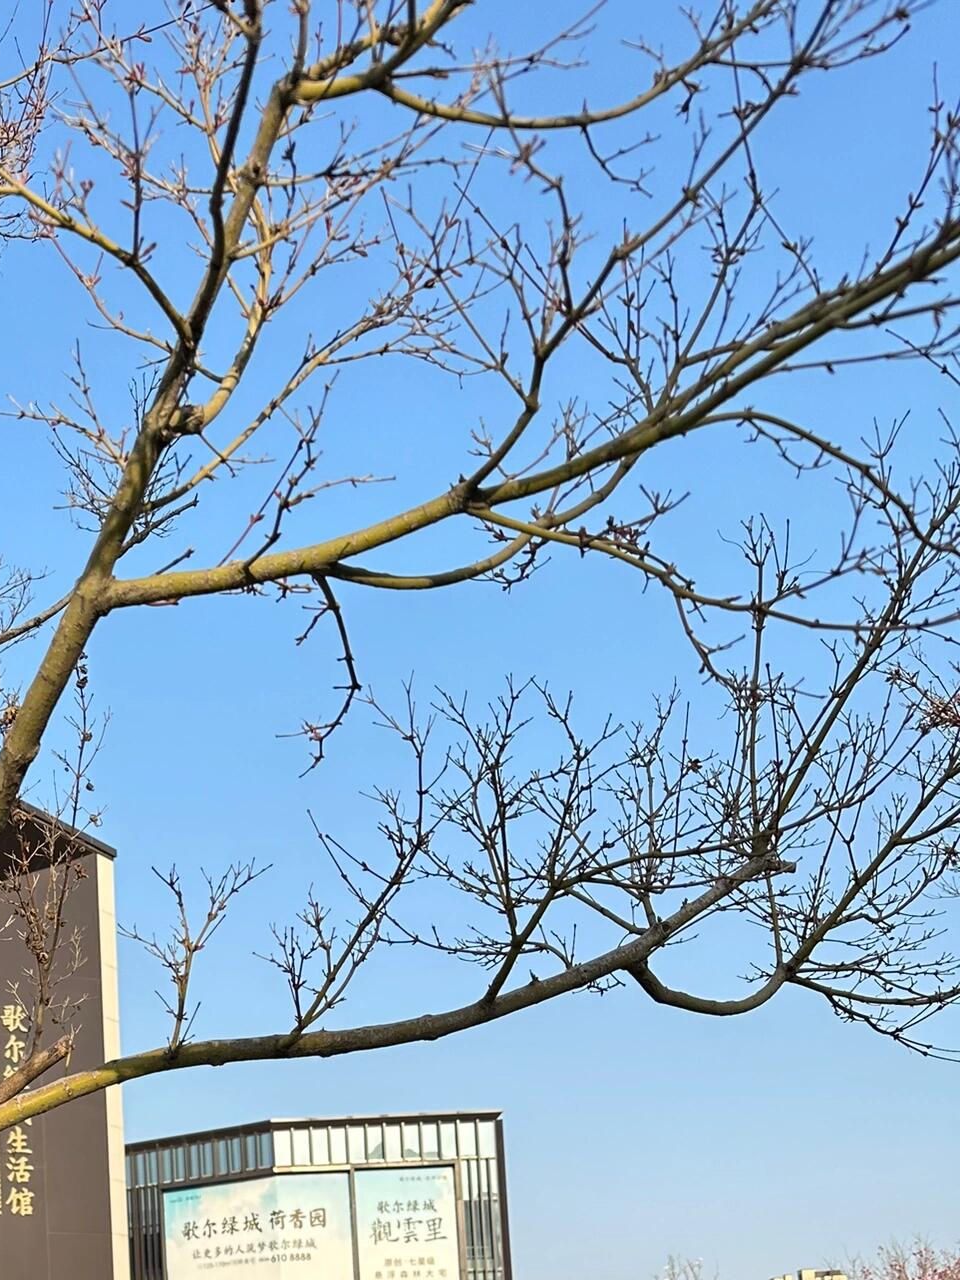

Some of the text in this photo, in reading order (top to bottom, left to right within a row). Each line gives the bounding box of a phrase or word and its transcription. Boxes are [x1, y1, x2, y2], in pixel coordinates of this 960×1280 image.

[0, 1005, 35, 1216] 歌尔生活馆
[376, 1199, 438, 1214] 歌尔绿城
[182, 1208, 327, 1241] 歌尔绿城 荷香园
[270, 1254, 288, 1264] 610
[289, 1253, 312, 1262] 8888
